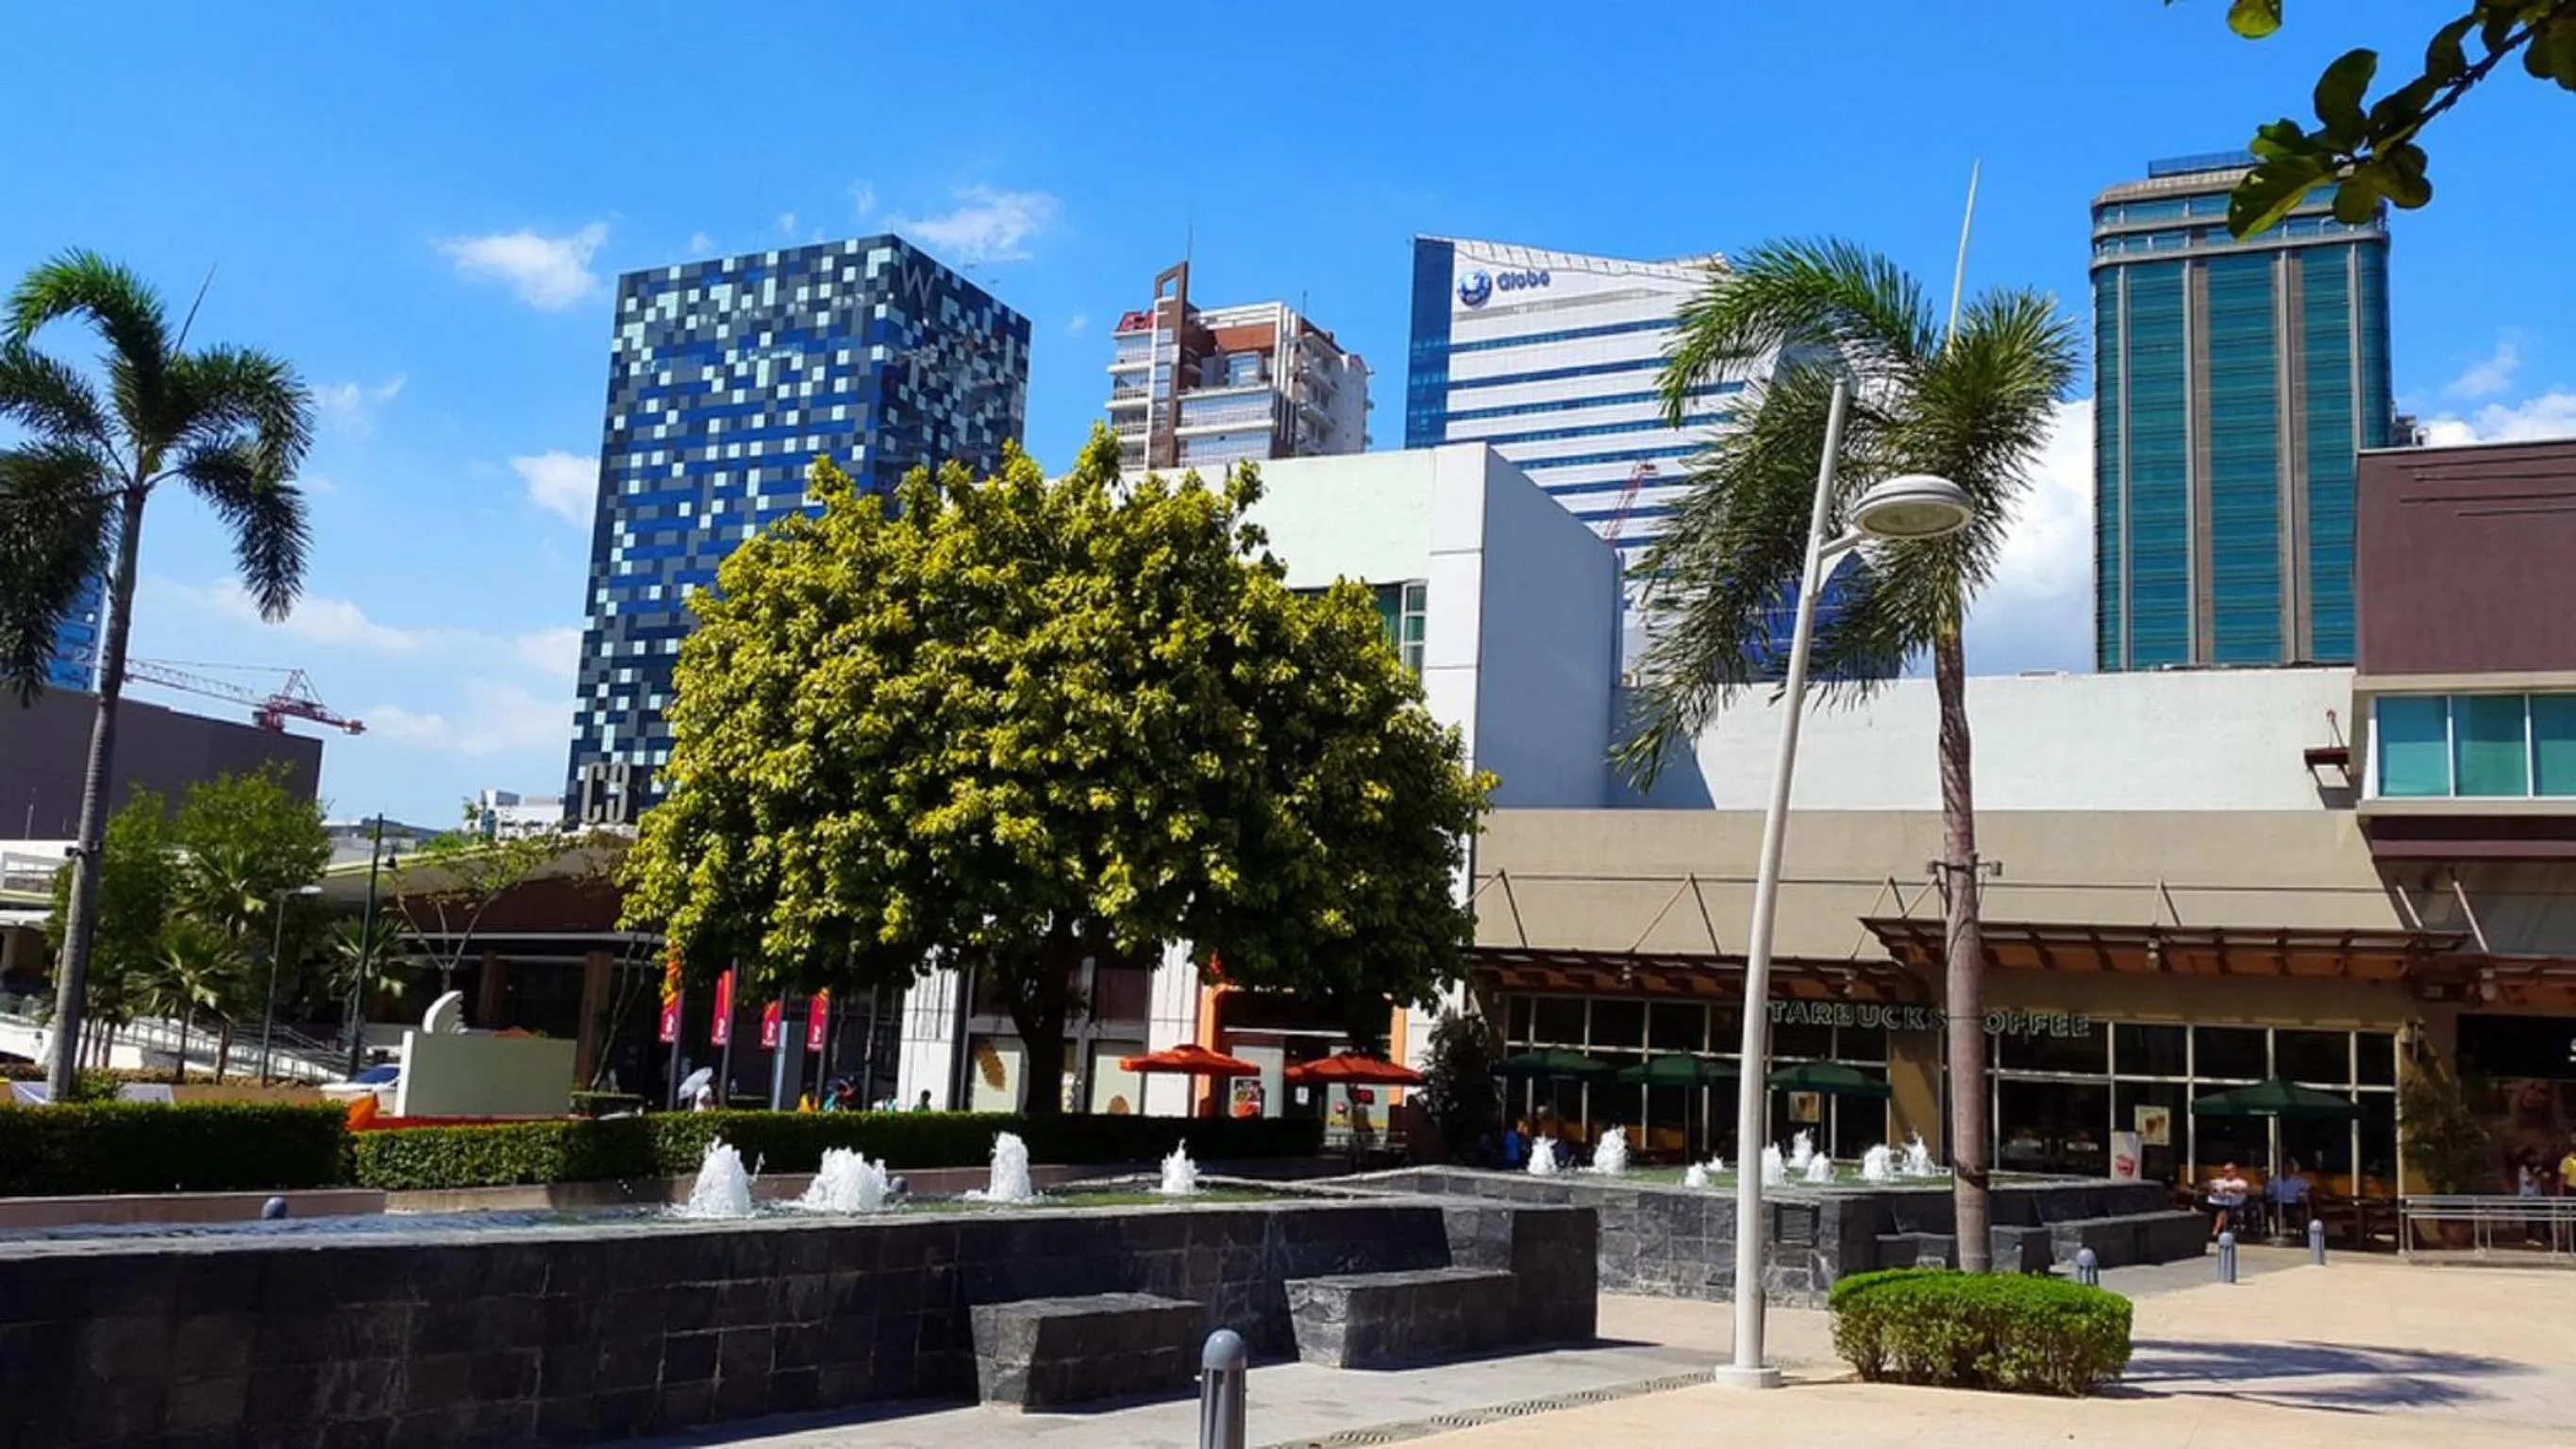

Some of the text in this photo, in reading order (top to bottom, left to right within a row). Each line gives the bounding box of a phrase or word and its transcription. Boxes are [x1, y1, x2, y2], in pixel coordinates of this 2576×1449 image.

[901, 259, 934, 308] W
[1497, 268, 1550, 291] Globe
[580, 761, 630, 824] C3
[1766, 1000, 2091, 1038] TARBUCKS OFFEE
